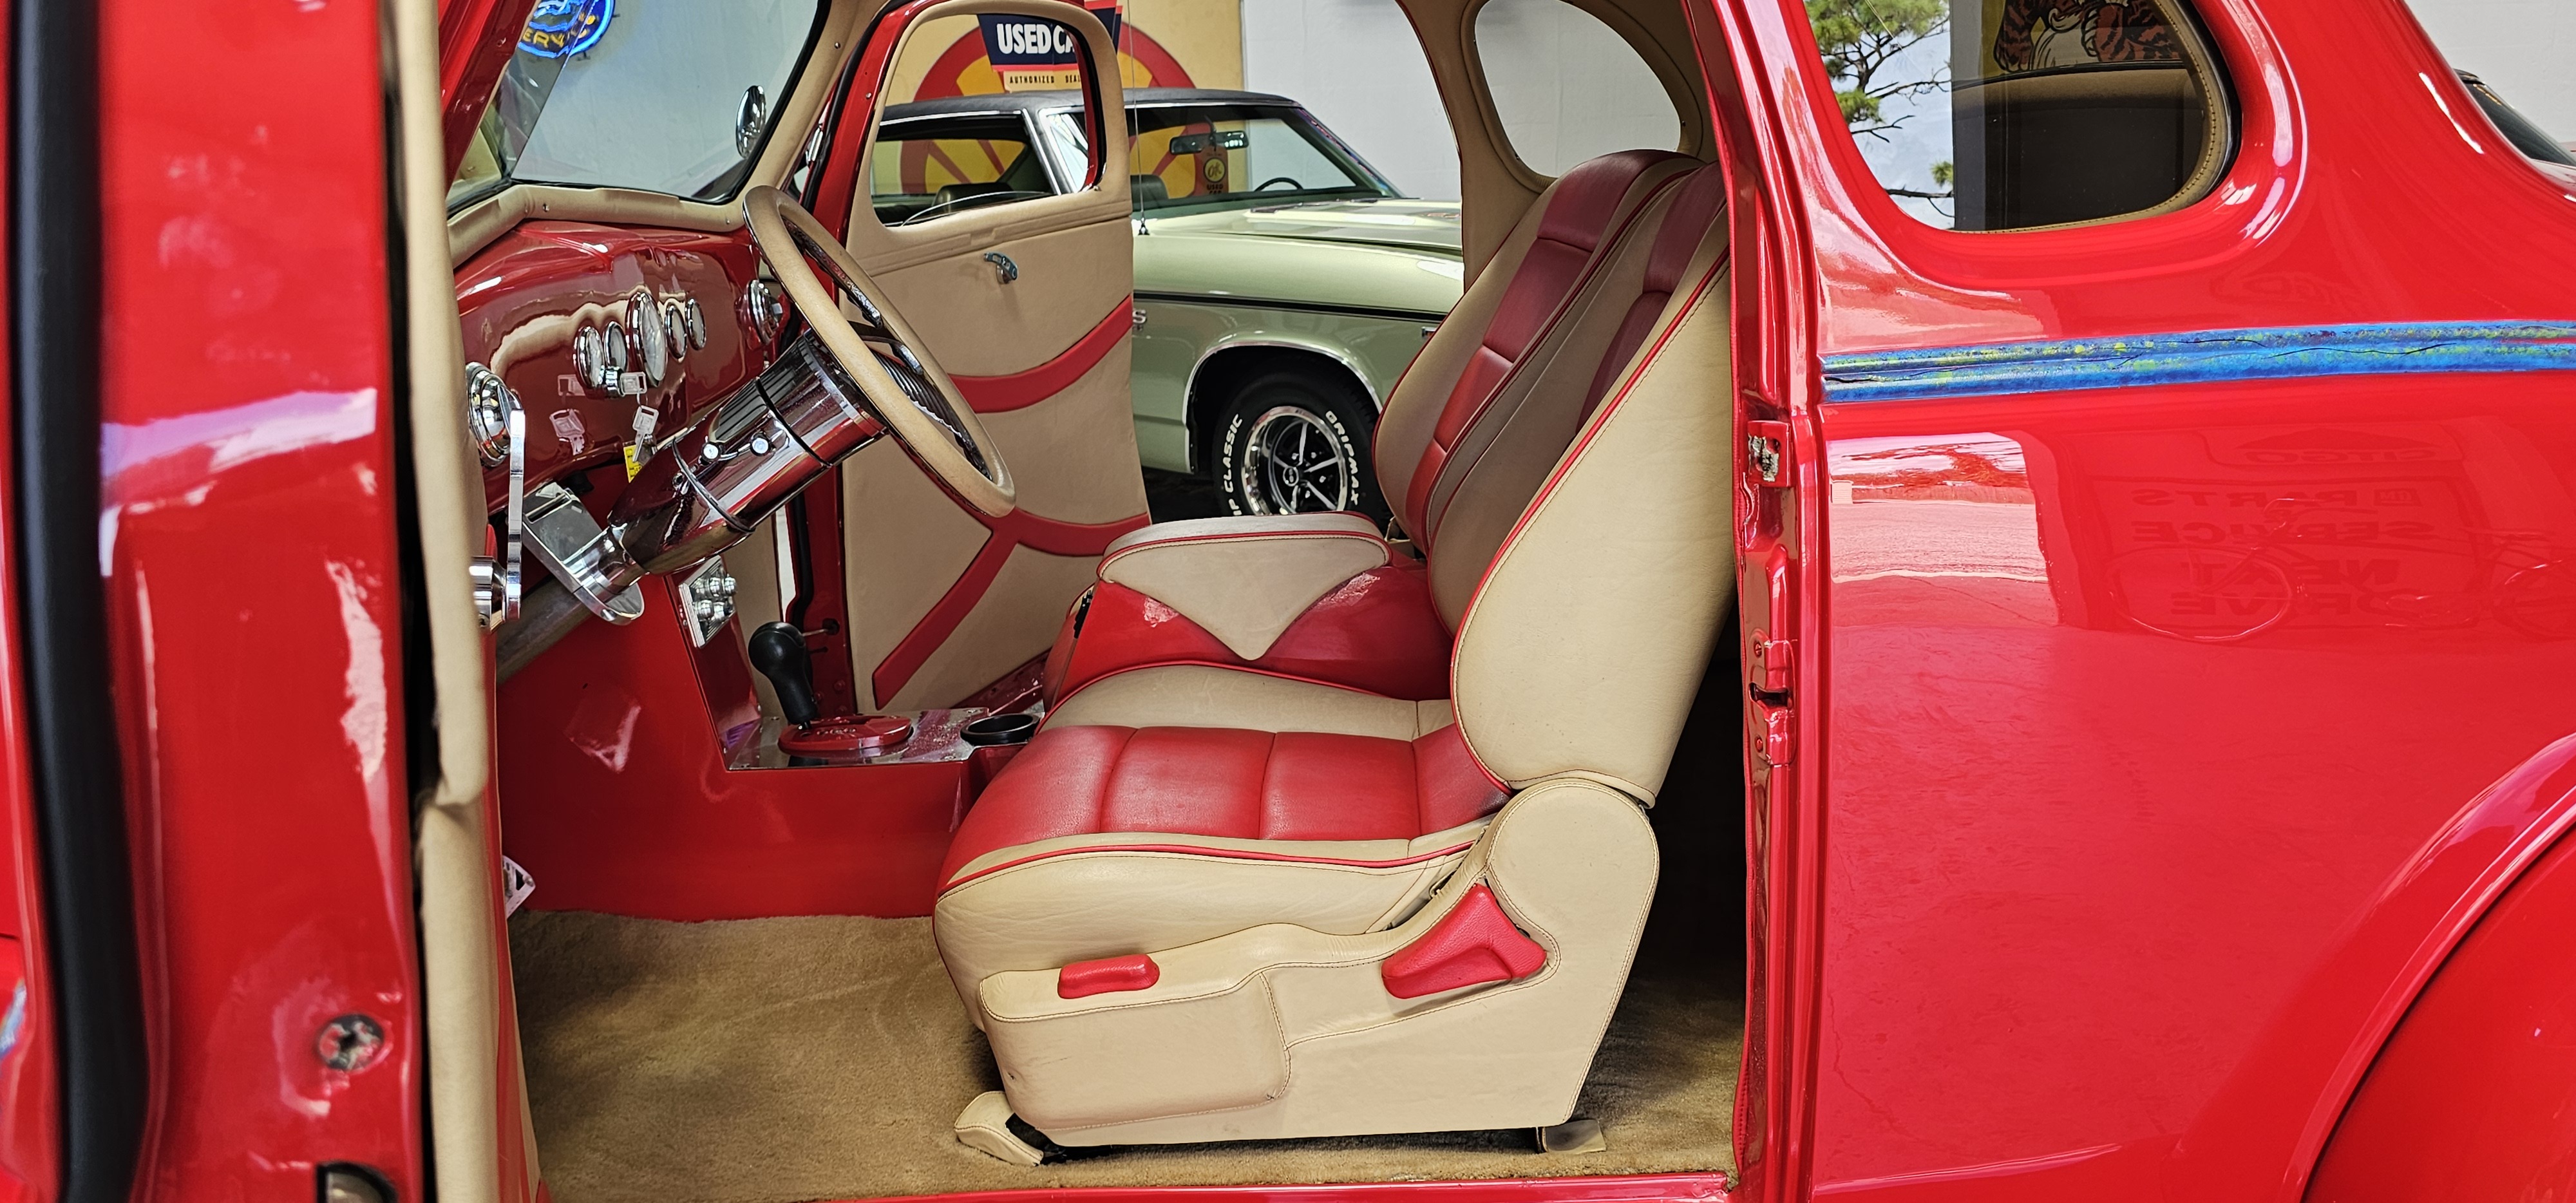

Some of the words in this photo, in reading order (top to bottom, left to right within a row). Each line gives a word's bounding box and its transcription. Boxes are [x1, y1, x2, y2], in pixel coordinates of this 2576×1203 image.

[996, 23, 1052, 54] USED
[1009, 75, 1054, 84] AUTHORIZED
[1223, 413, 1243, 493] CLASSIC
[1325, 410, 1359, 506] GRIPMAX
